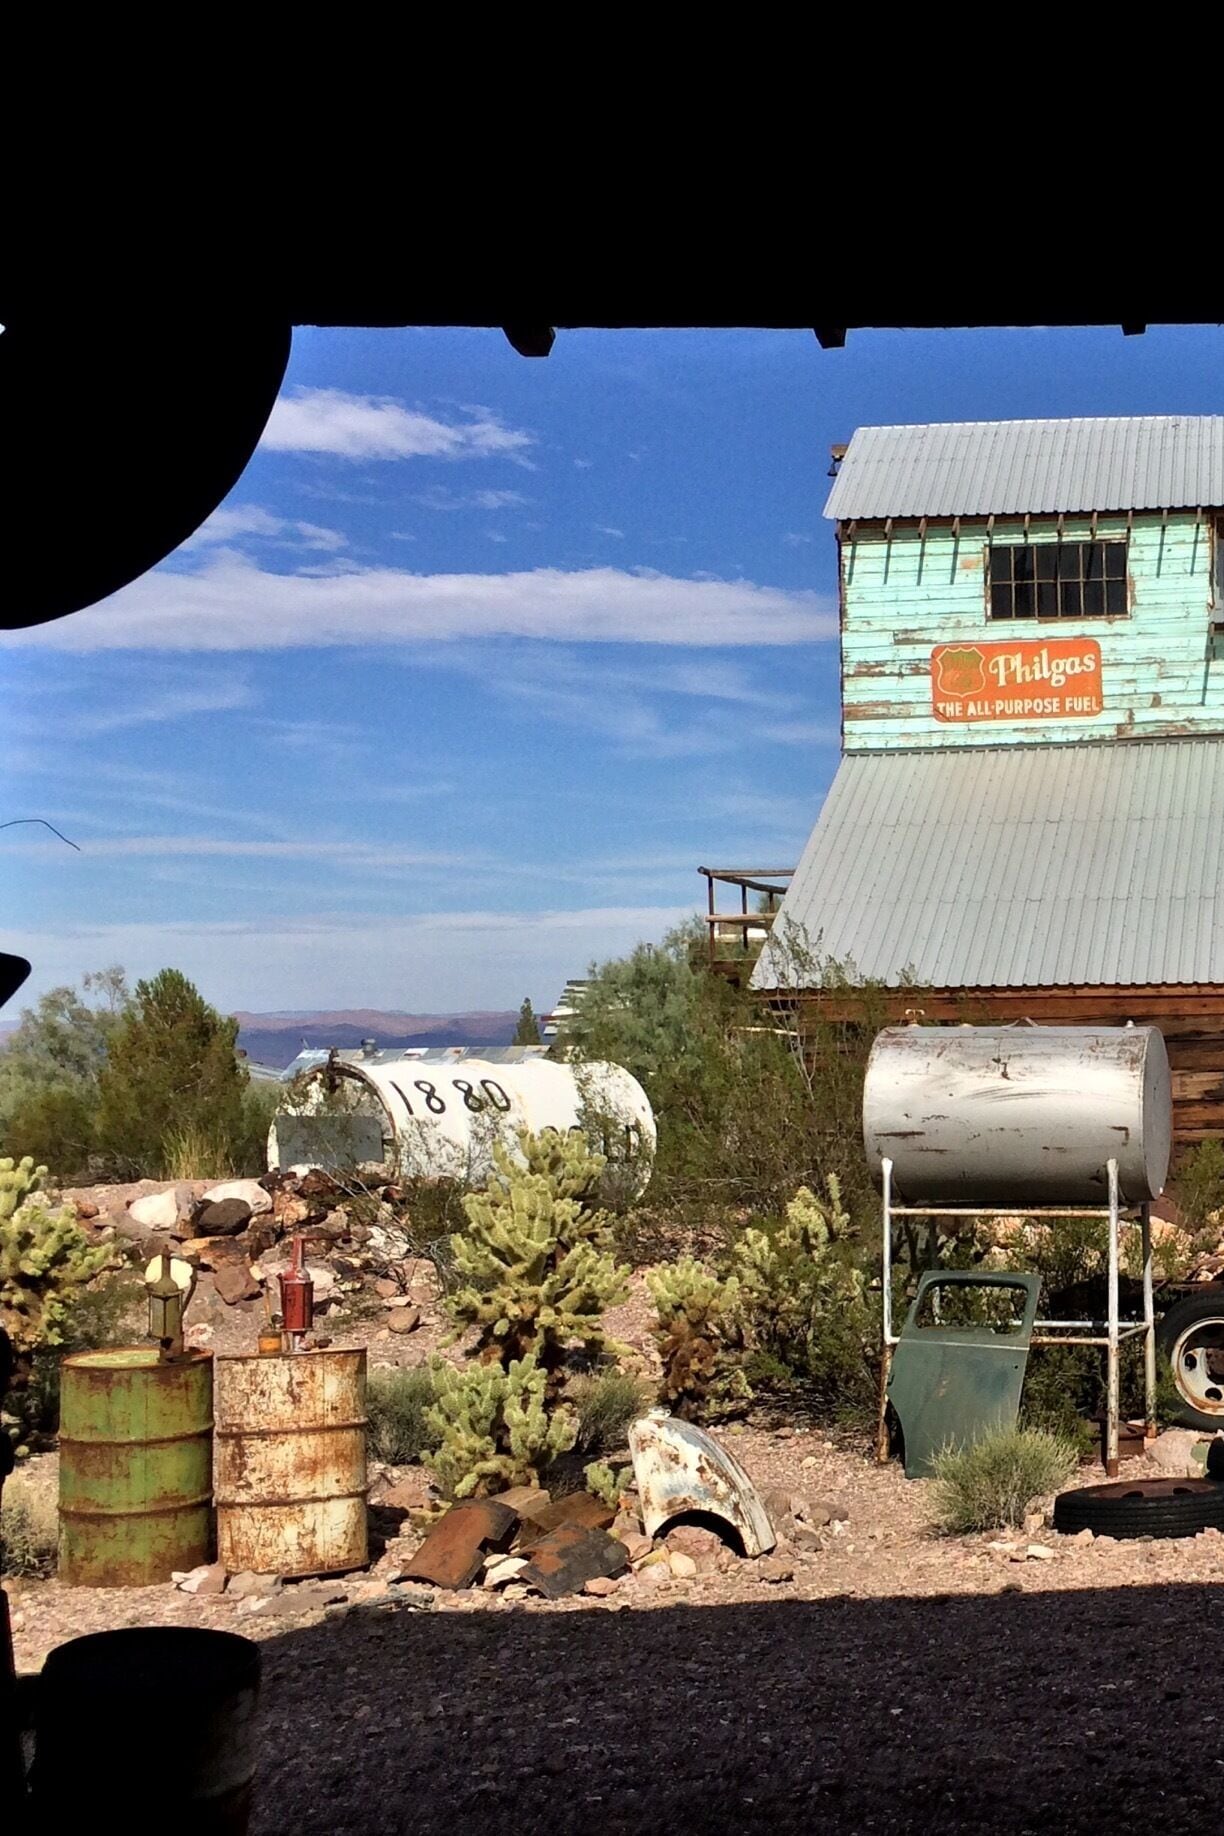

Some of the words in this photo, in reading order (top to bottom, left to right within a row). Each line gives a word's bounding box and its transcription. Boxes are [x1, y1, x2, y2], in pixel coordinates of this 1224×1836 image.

[989, 649, 1096, 687] Philgas
[937, 702, 963, 717] THE
[1065, 696, 1099, 712] FUEL
[389, 1079, 511, 1115] 1880
